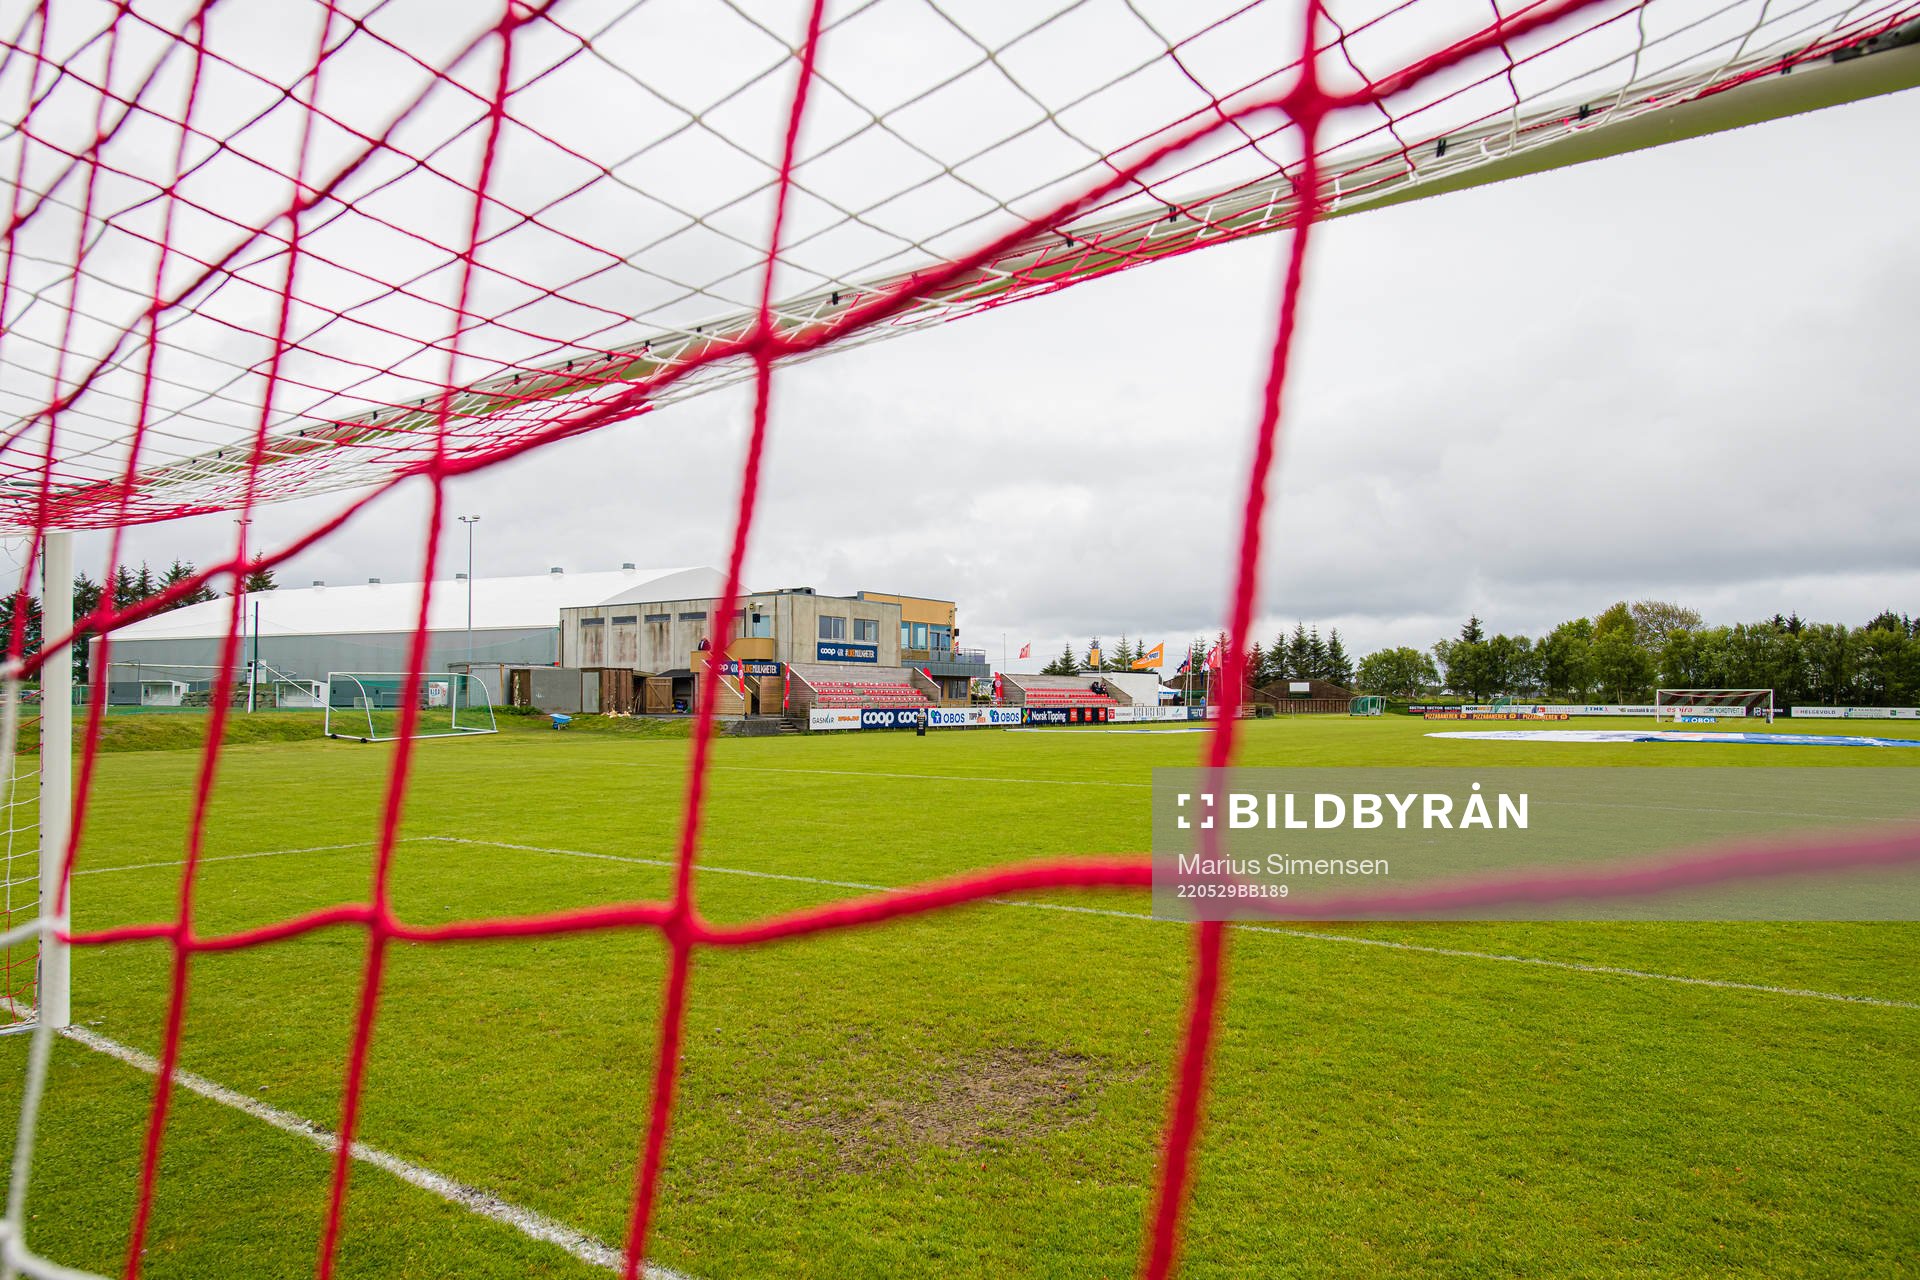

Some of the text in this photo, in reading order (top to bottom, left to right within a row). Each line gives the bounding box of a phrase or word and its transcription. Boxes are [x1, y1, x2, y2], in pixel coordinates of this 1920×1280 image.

[820, 648, 836, 656] coop
[863, 711, 895, 727] coop
[943, 713, 965, 723] OBOS
[1001, 712, 1020, 722] OBOS
[1031, 711, 1047, 721] Norsk
[1047, 711, 1067, 722] Tipping
